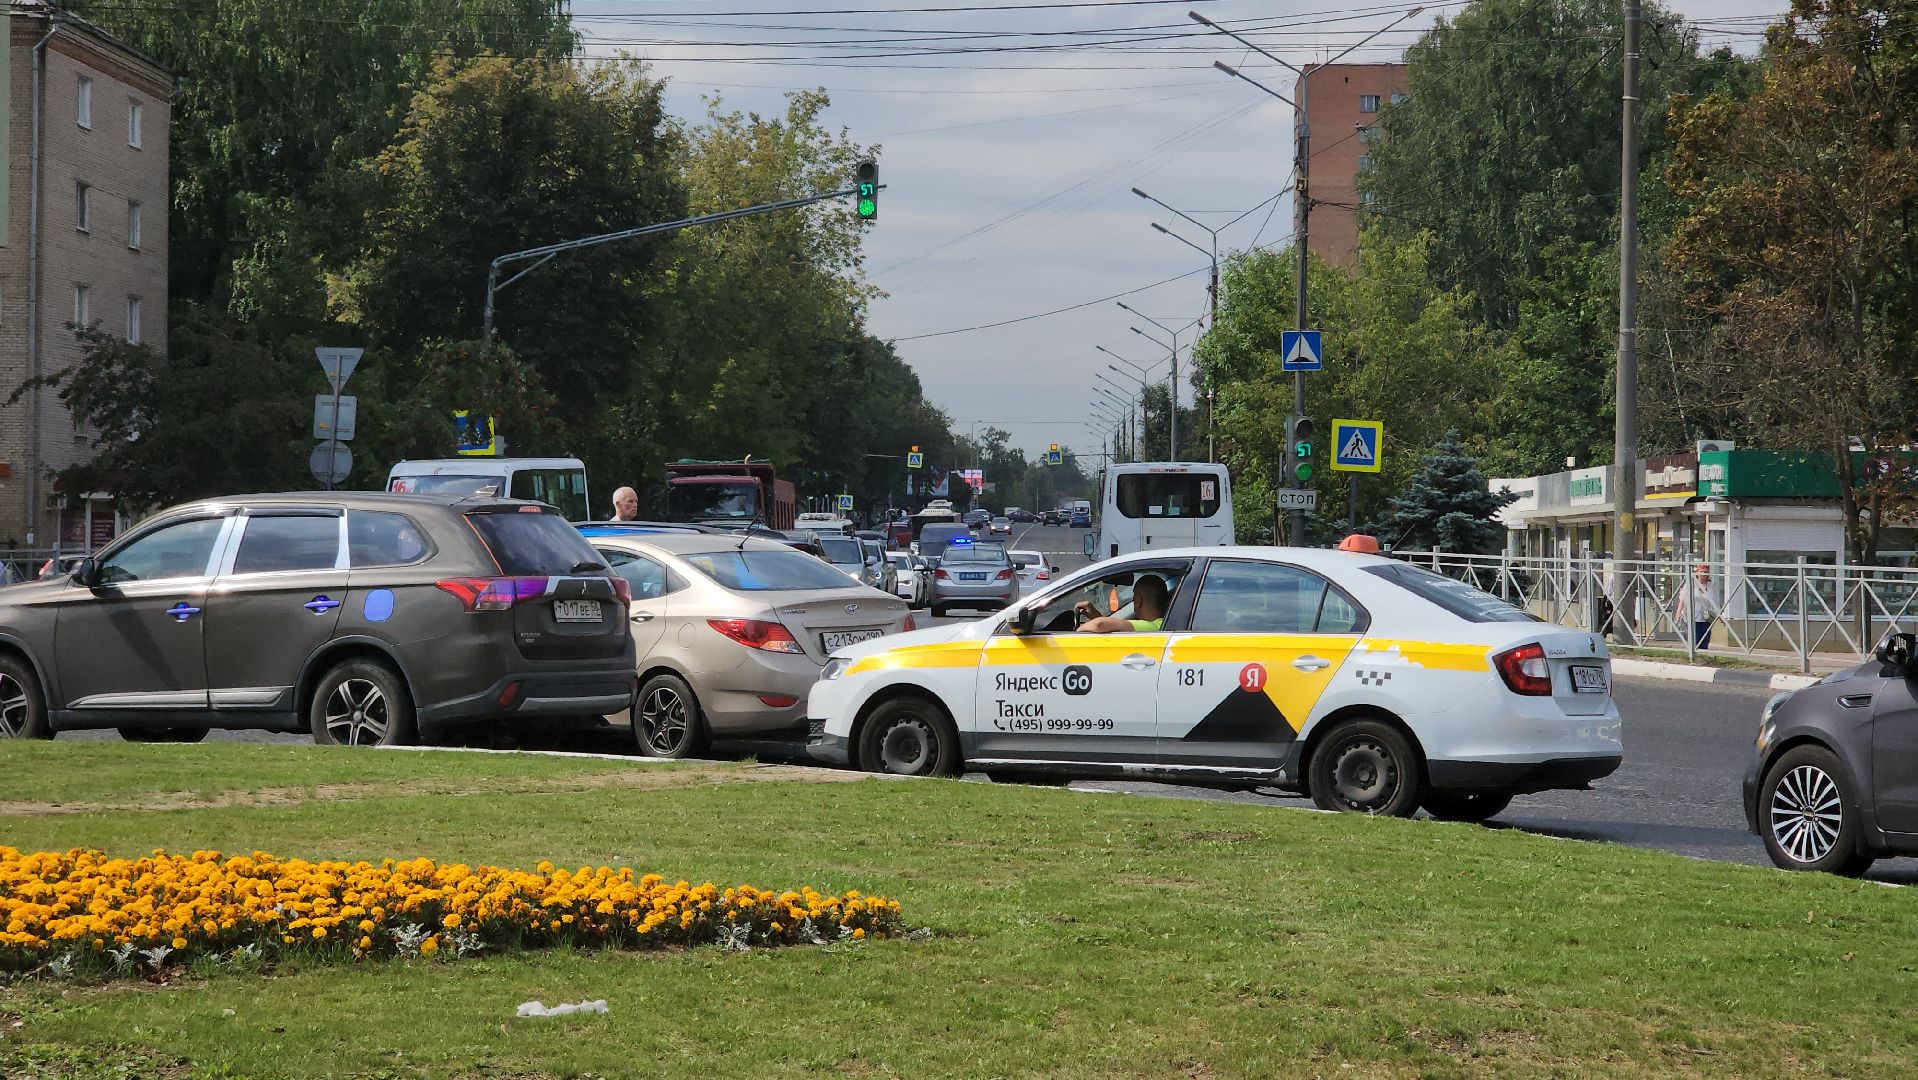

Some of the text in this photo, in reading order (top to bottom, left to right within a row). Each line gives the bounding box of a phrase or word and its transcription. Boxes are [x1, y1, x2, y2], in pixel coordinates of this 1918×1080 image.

[861, 183, 873, 195] 57
[1297, 442, 1311, 457] 57
[1280, 493, 1314, 504] СТОП
[995, 670, 1090, 691] Яндекс Go
[1176, 668, 1205, 687] 181
[1246, 668, 1260, 688] Я
[995, 699, 1045, 718] Такси
[1009, 718, 1114, 732] (495) 999-99-99
